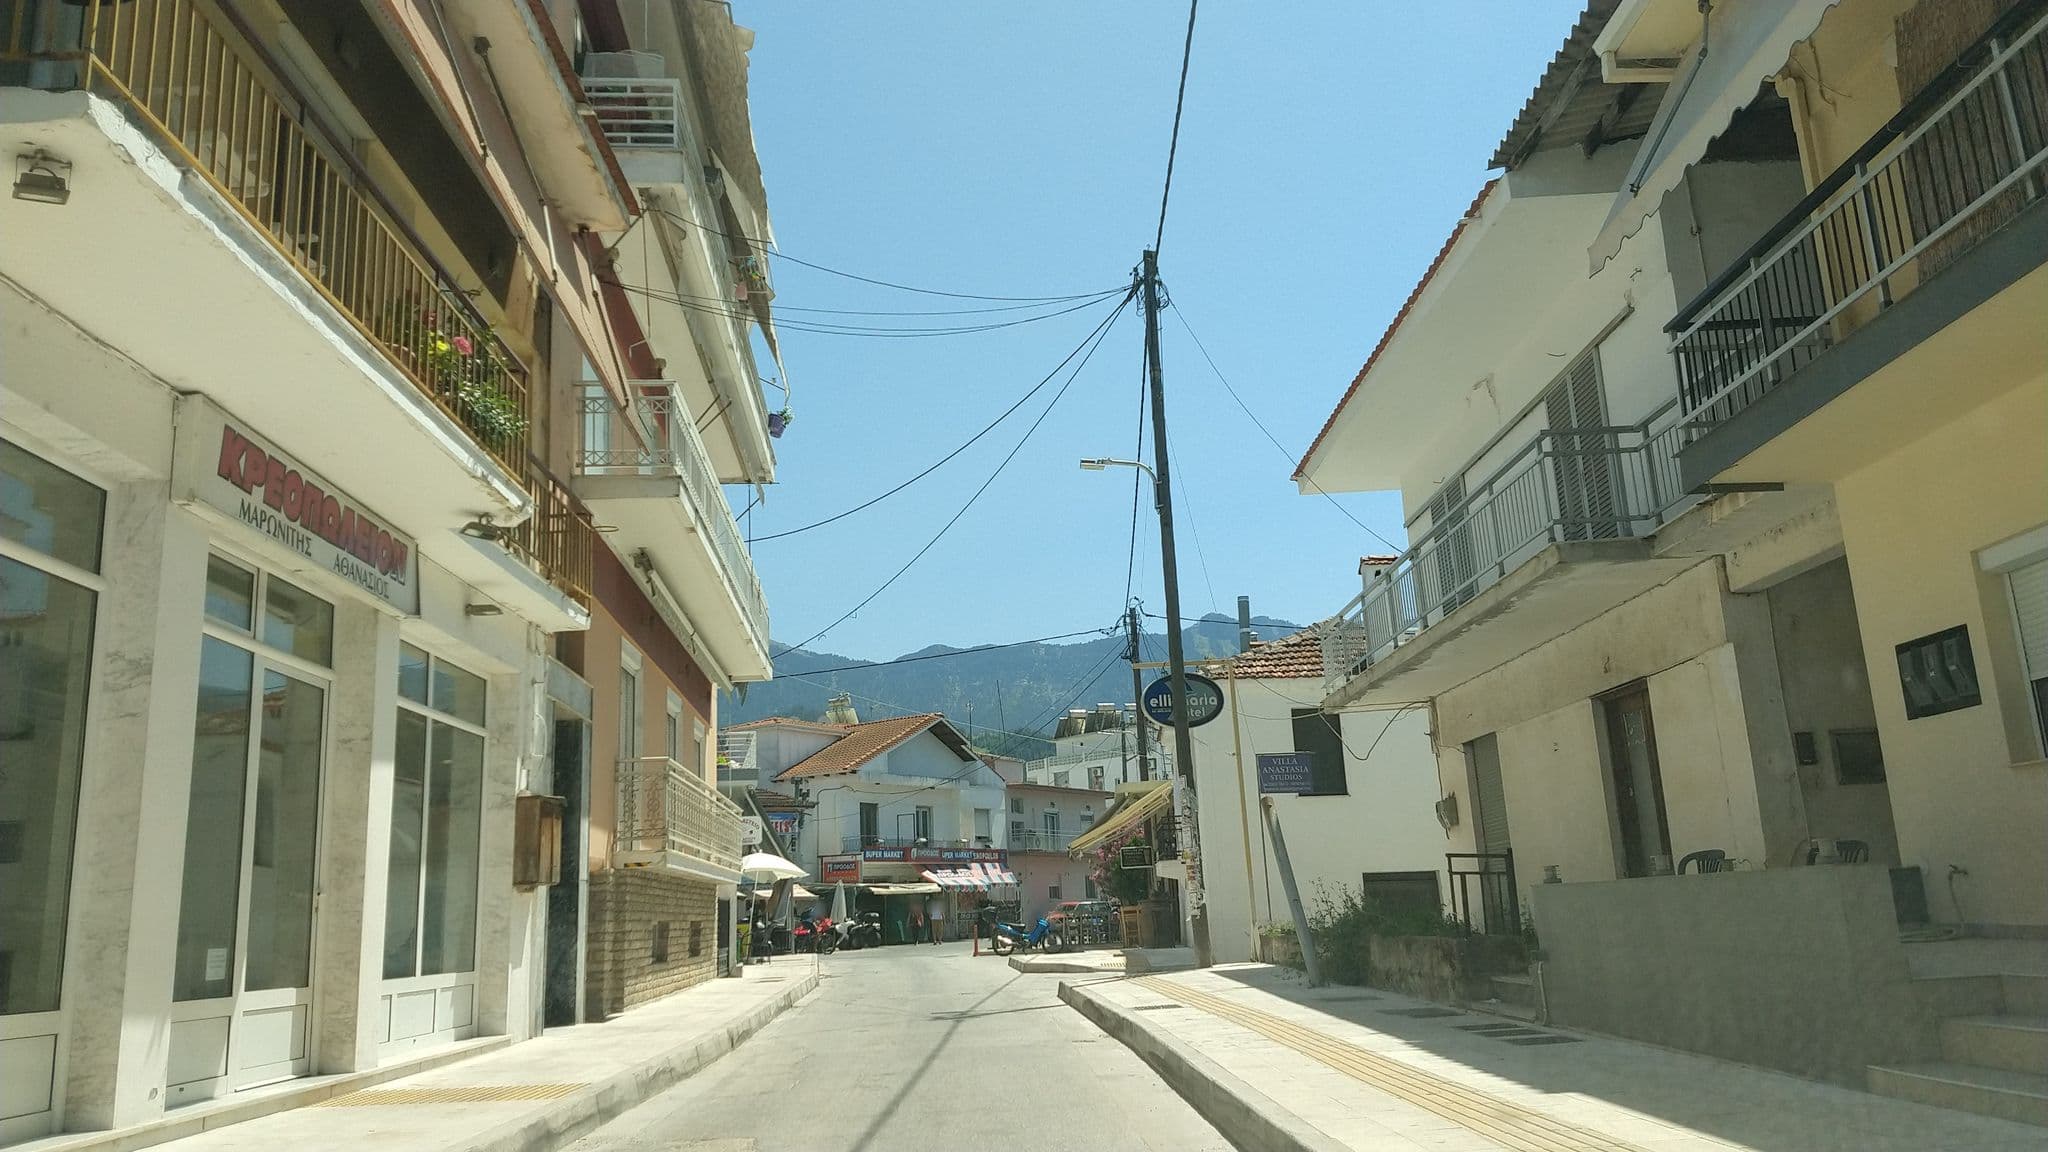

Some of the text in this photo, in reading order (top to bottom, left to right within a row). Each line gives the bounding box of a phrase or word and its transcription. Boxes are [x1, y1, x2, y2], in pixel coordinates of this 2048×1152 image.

[217, 423, 409, 586] ΚΡΕΟΠΩΛΕΙΟΝ
[238, 497, 390, 600] ΜΑΡΩΝΙΤΗΣ ΑΘΑΝΑΣΙΟΣ
[1272, 757, 1299, 765] VILLA
[1262, 765, 1309, 774] ANASTASIA
[1270, 773, 1304, 781] STUDIOS
[883, 850, 904, 859] MARKET
